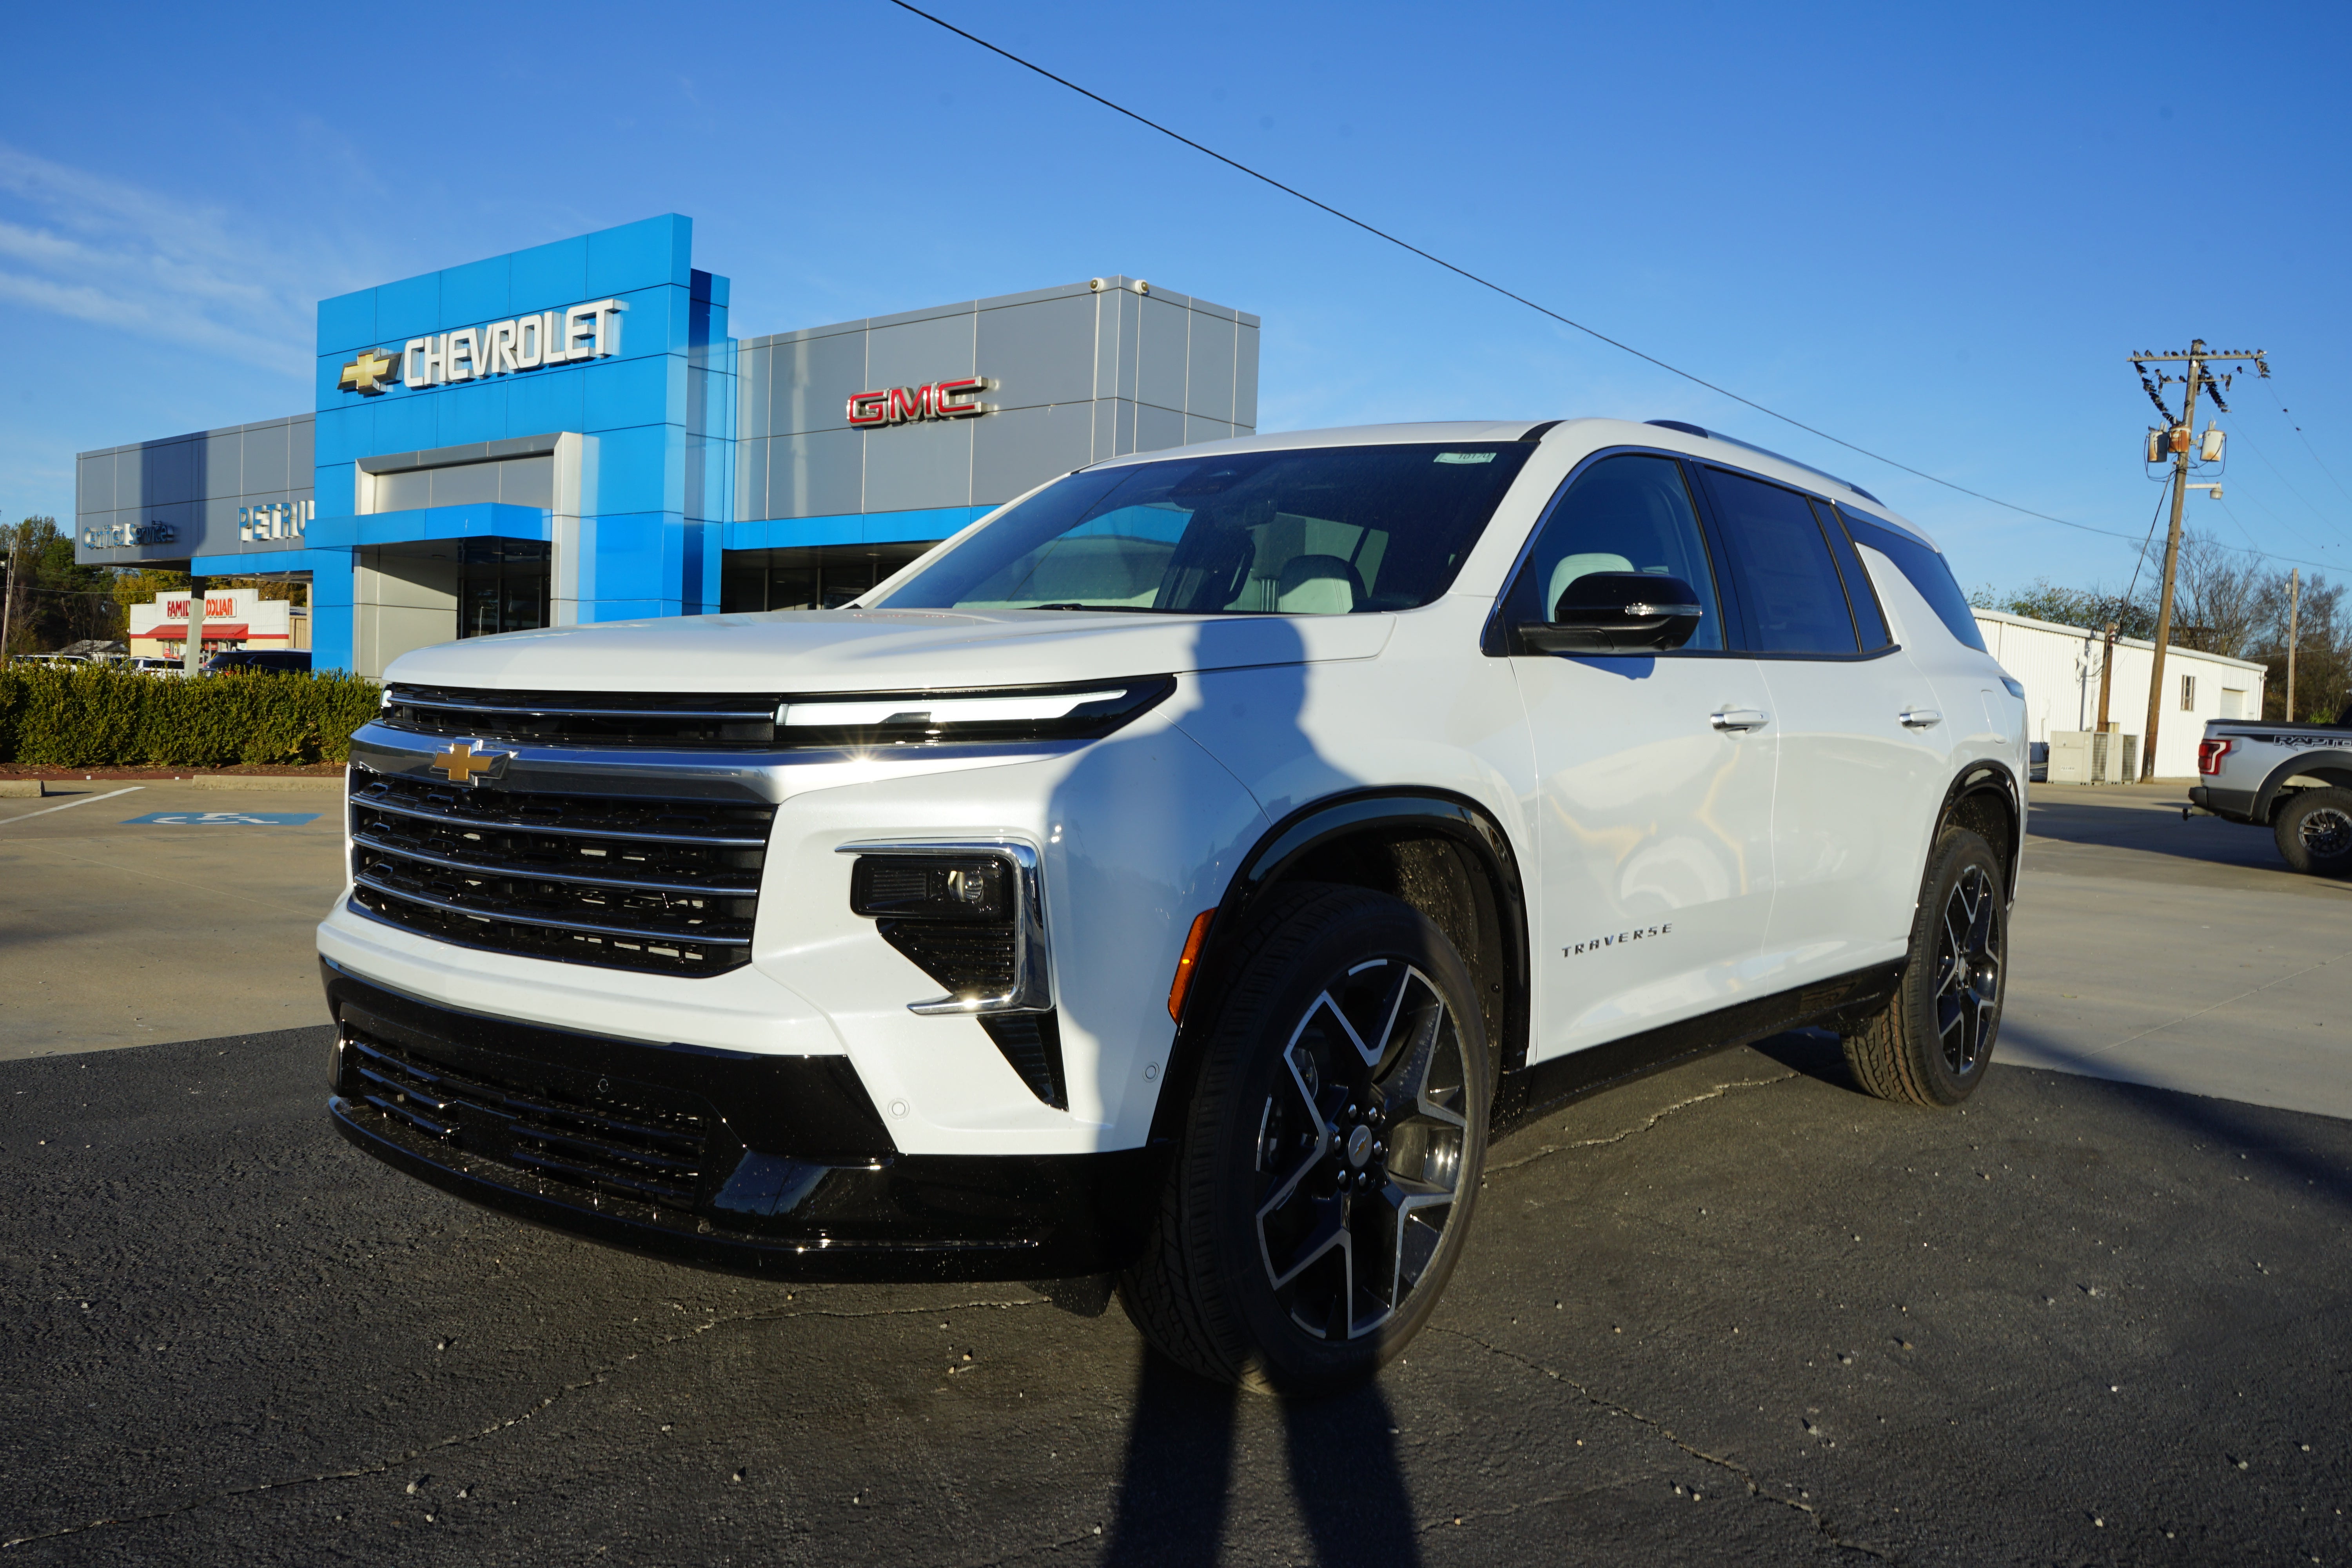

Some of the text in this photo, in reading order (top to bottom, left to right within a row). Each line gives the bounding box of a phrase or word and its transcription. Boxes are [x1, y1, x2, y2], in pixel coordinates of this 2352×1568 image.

[404, 299, 617, 388] CHEVROLET
[847, 376, 987, 426] GMC
[84, 521, 169, 548] Certified Service
[206, 598, 232, 616] DOLLAR
[1562, 922, 1672, 958] TRAVERSE
